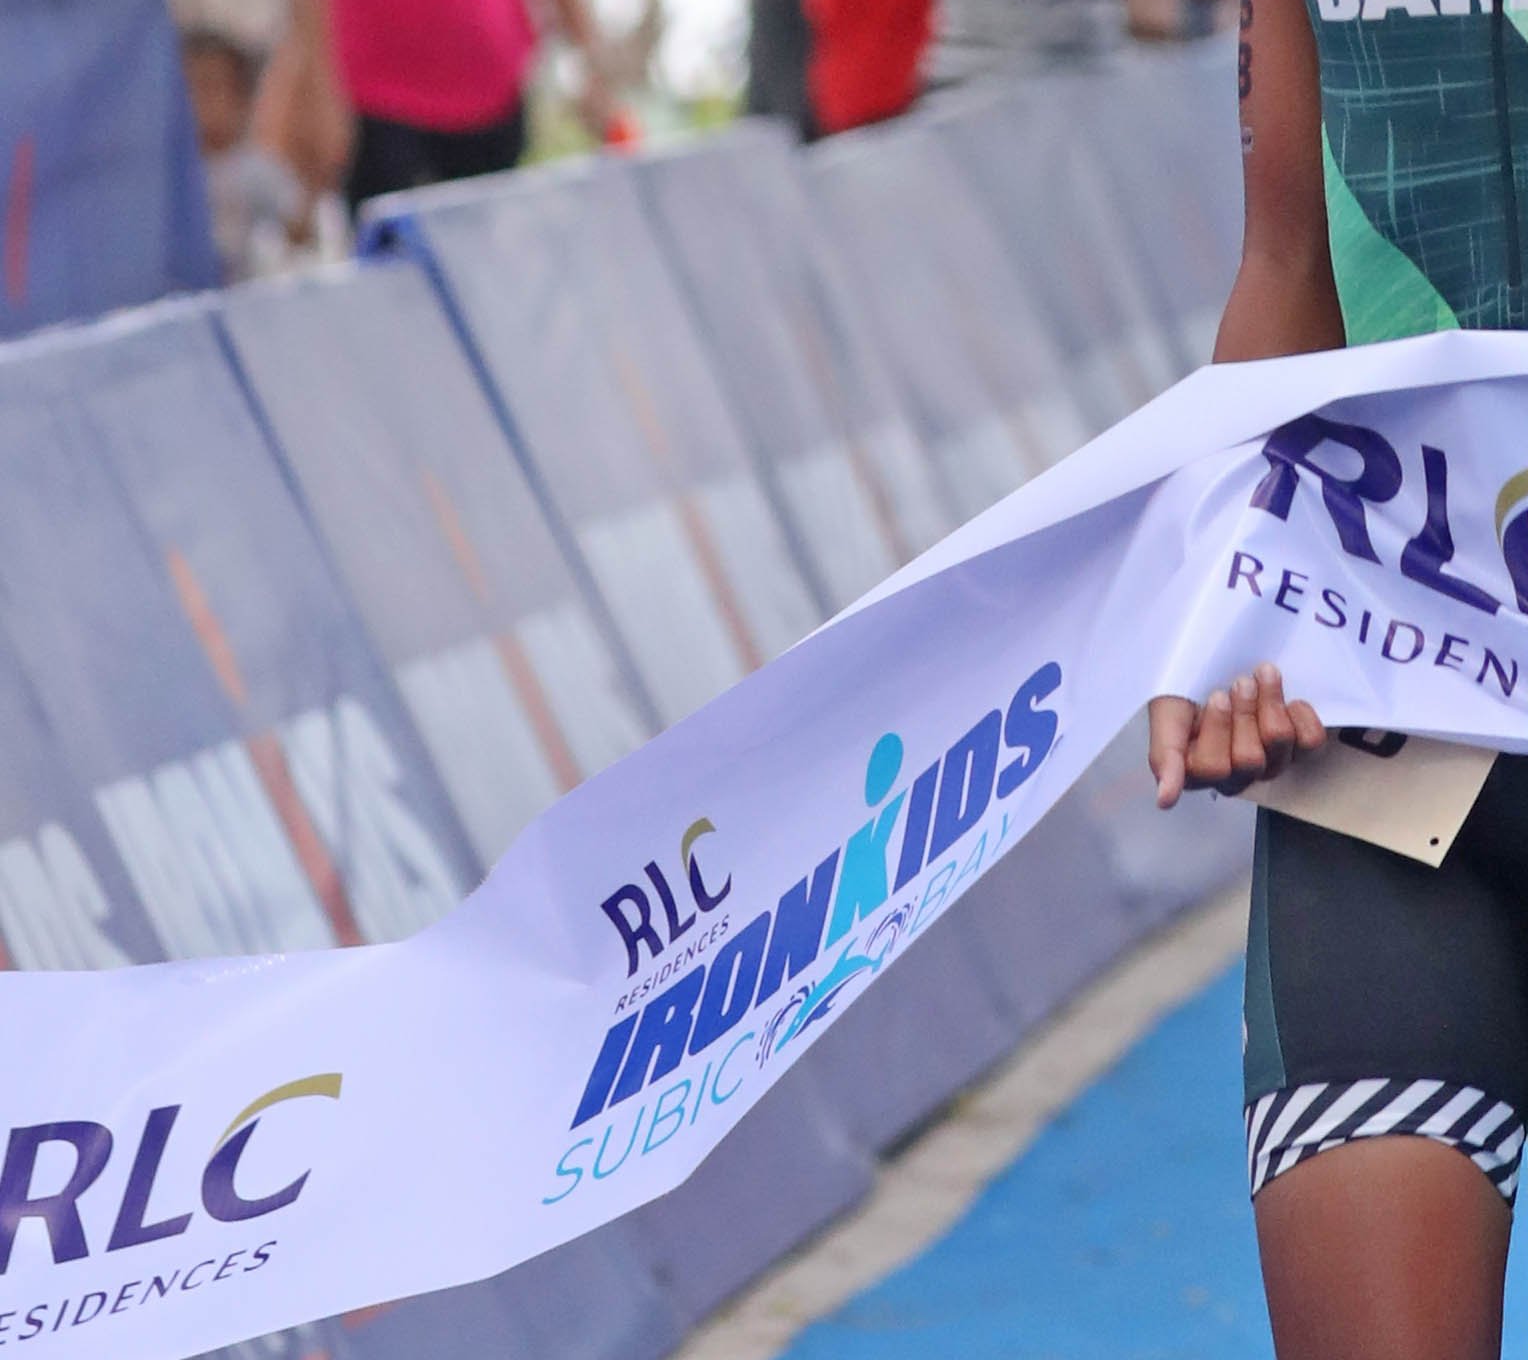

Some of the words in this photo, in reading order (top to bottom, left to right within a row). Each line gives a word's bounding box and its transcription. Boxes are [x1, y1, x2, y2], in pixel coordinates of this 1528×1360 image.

[569, 660, 1063, 1131] IRONKIDS
[600, 817, 732, 979] RLC
[614, 913, 730, 1015] RESIDENCES
[541, 1031, 756, 1206] SUBIC
[907, 810, 1010, 937] BAY
[0, 1072, 343, 1276] RLC
[0, 1240, 278, 1346] ESIDENCES
